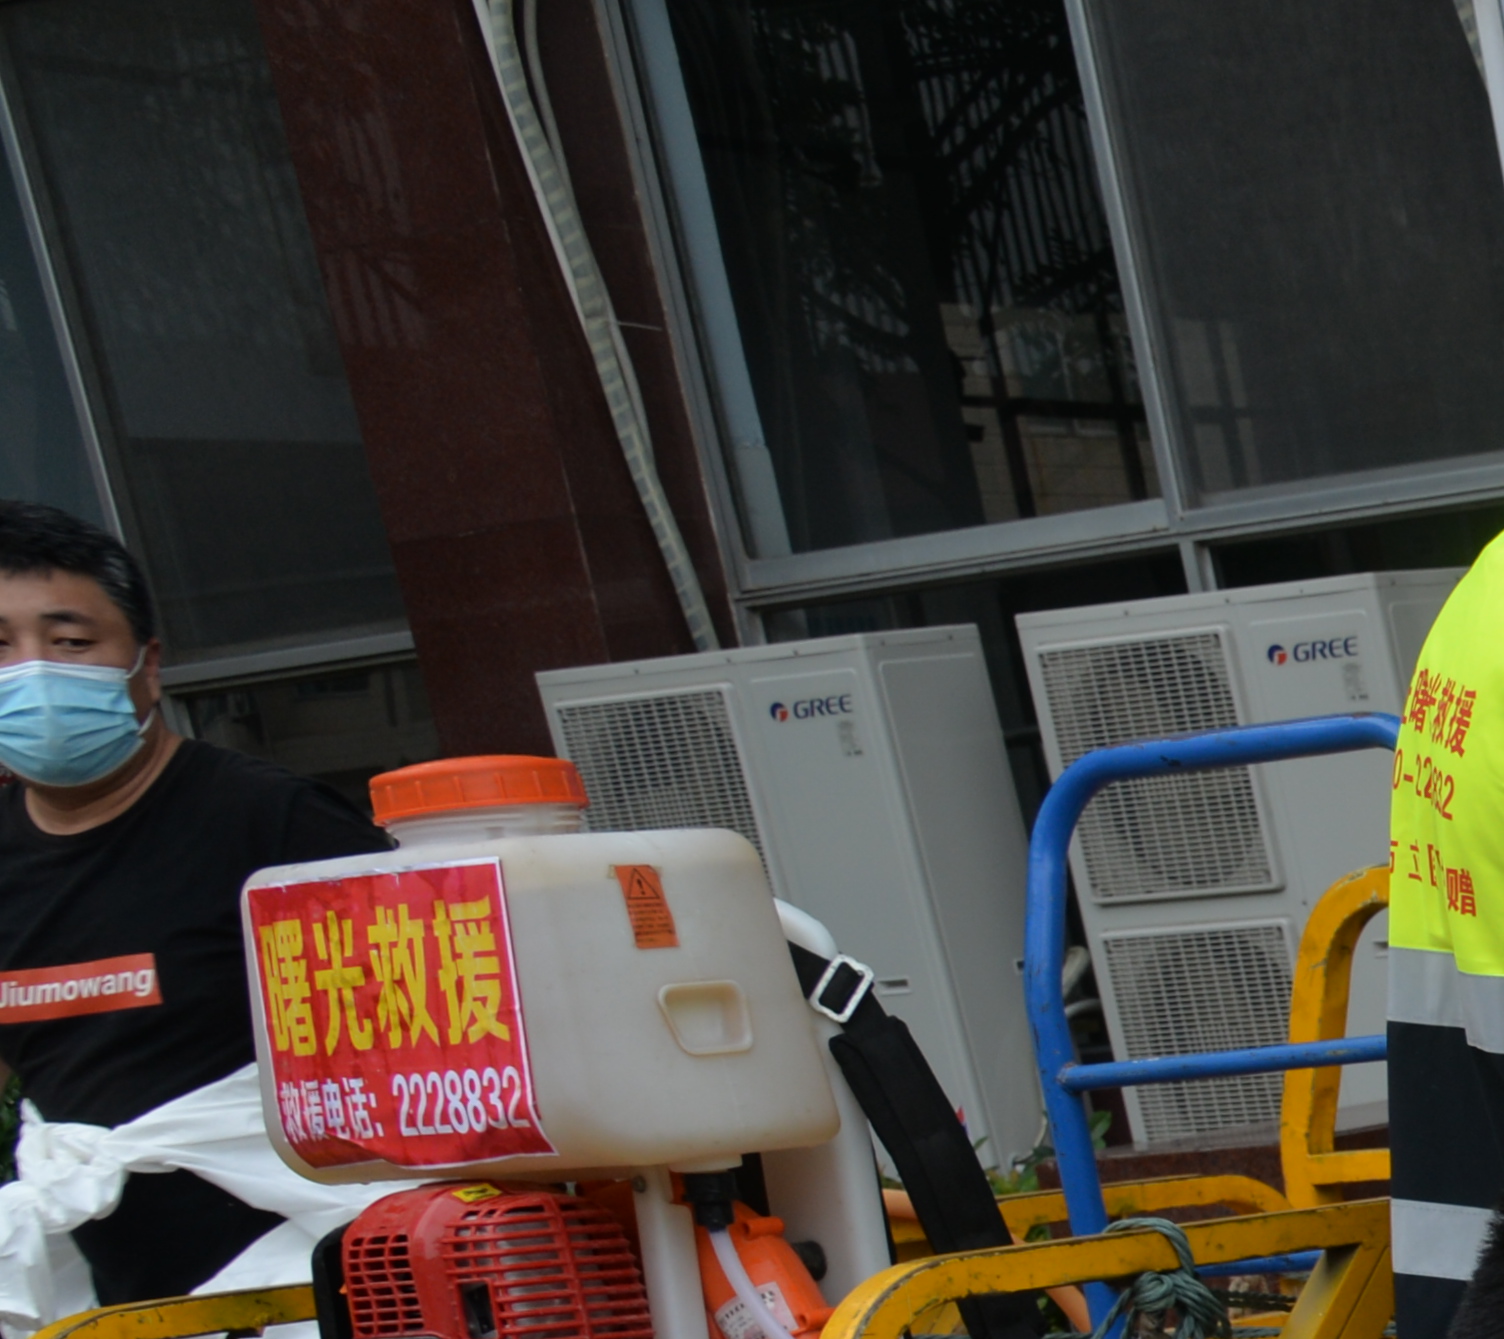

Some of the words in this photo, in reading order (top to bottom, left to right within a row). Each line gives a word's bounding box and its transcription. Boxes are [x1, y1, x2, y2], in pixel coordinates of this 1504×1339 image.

[1293, 636, 1358, 662] GREE
[793, 694, 853, 720] GREE
[258, 893, 513, 1059] 曙光救援
